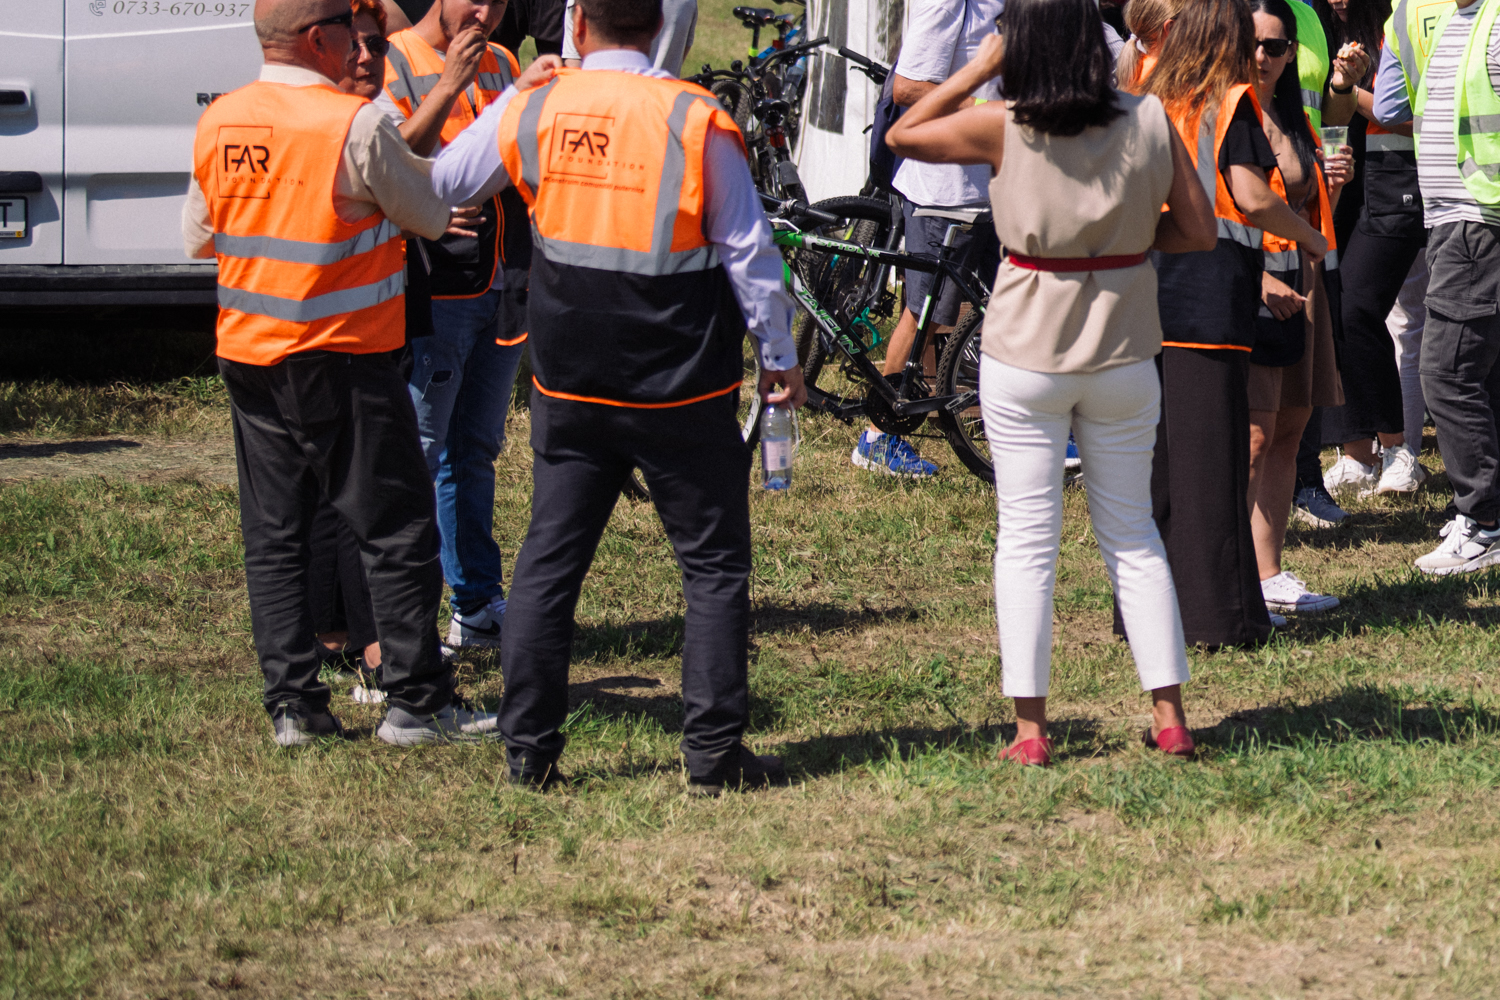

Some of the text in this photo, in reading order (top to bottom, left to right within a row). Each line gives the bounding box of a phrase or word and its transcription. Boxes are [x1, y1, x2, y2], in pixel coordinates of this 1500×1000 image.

[113, 0, 250, 17] 0733-670-937
[561, 129, 610, 157] FAR
[224, 144, 270, 173] FAR
[559, 156, 645, 170] FOUNDATION
[225, 176, 304, 187] FOUNDATION
[816, 238, 881, 258] SPIDER
[797, 285, 861, 355] TAIFUN
